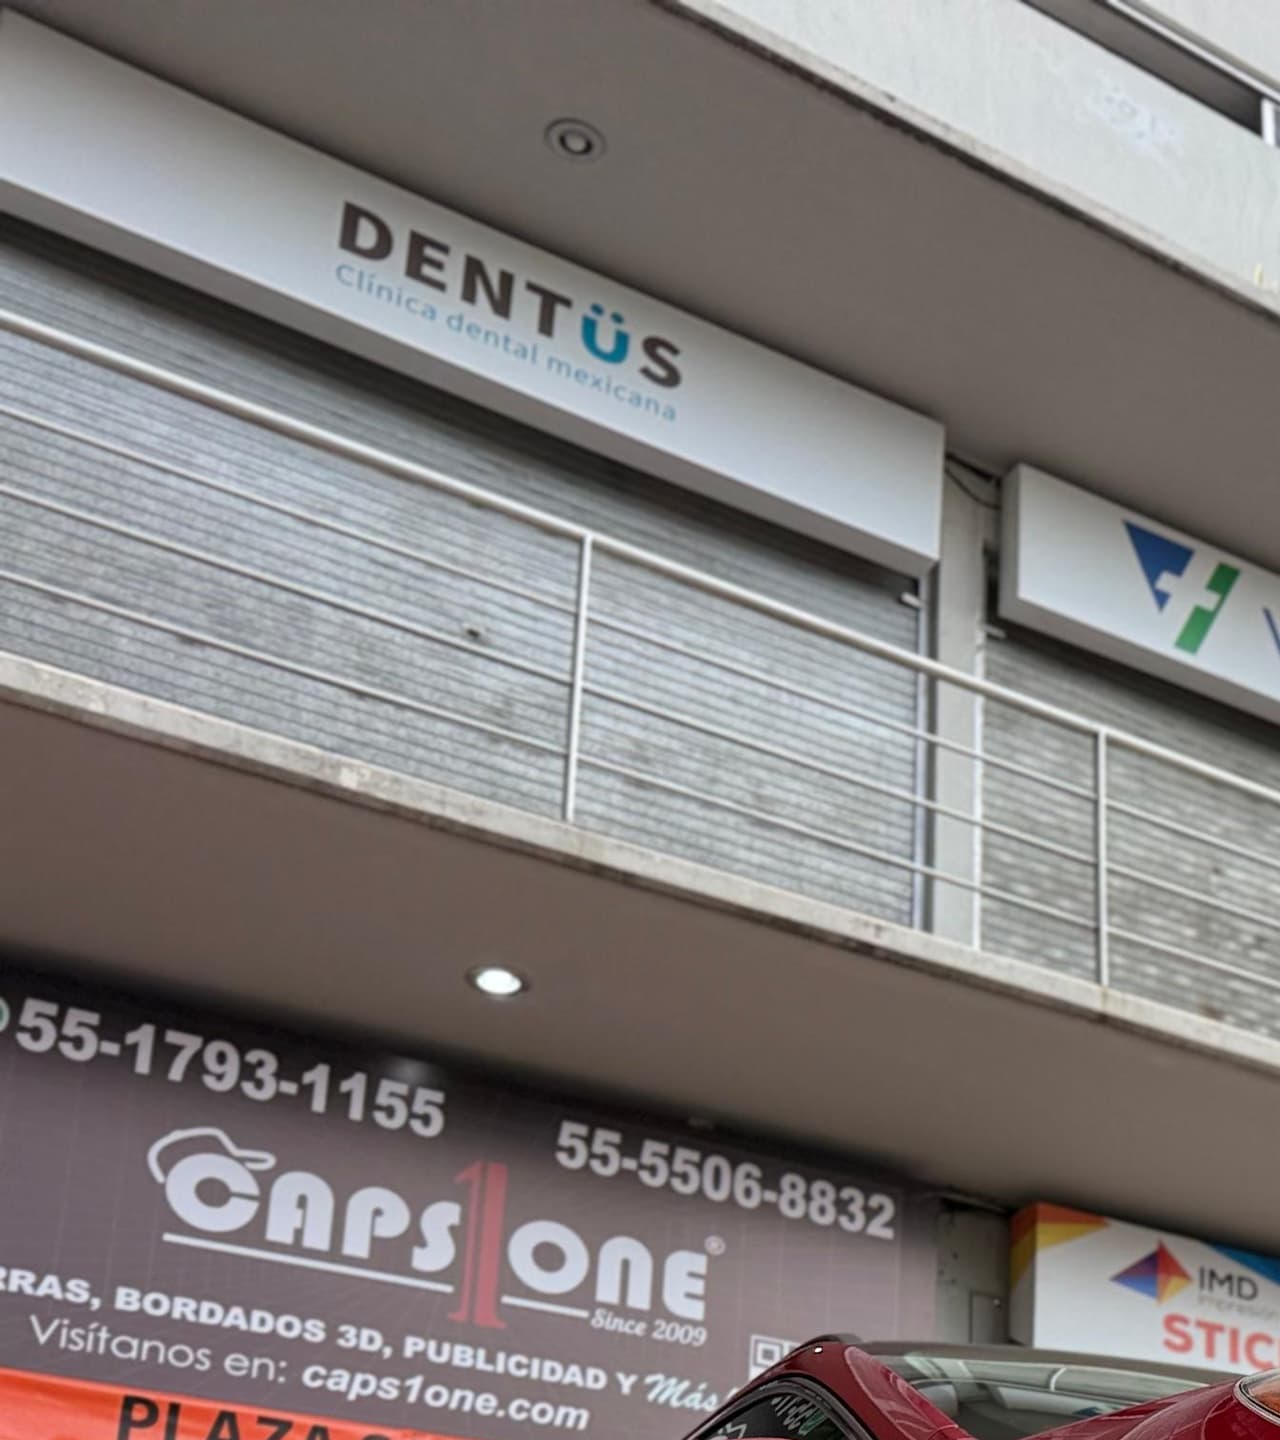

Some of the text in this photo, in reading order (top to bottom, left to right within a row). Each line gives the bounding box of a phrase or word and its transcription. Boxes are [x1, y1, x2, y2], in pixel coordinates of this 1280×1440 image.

[335, 263, 677, 422] Clínica dental mexicana
[339, 200, 684, 389] DENTÜS
[15, 997, 447, 1138] 55-1793-1155
[554, 1119, 897, 1240] 55-5506-8832
[114, 1286, 327, 1343] BORDADOS
[336, 1325, 394, 1360] 3D,
[403, 1336, 608, 1391] PUBLICIDAD
[615, 1374, 639, 1396] Y
[591, 1308, 708, 1347] Since 2009
[1198, 1267, 1259, 1301] IMD
[30, 1314, 590, 1431] Visítanos en: caps1one.com
